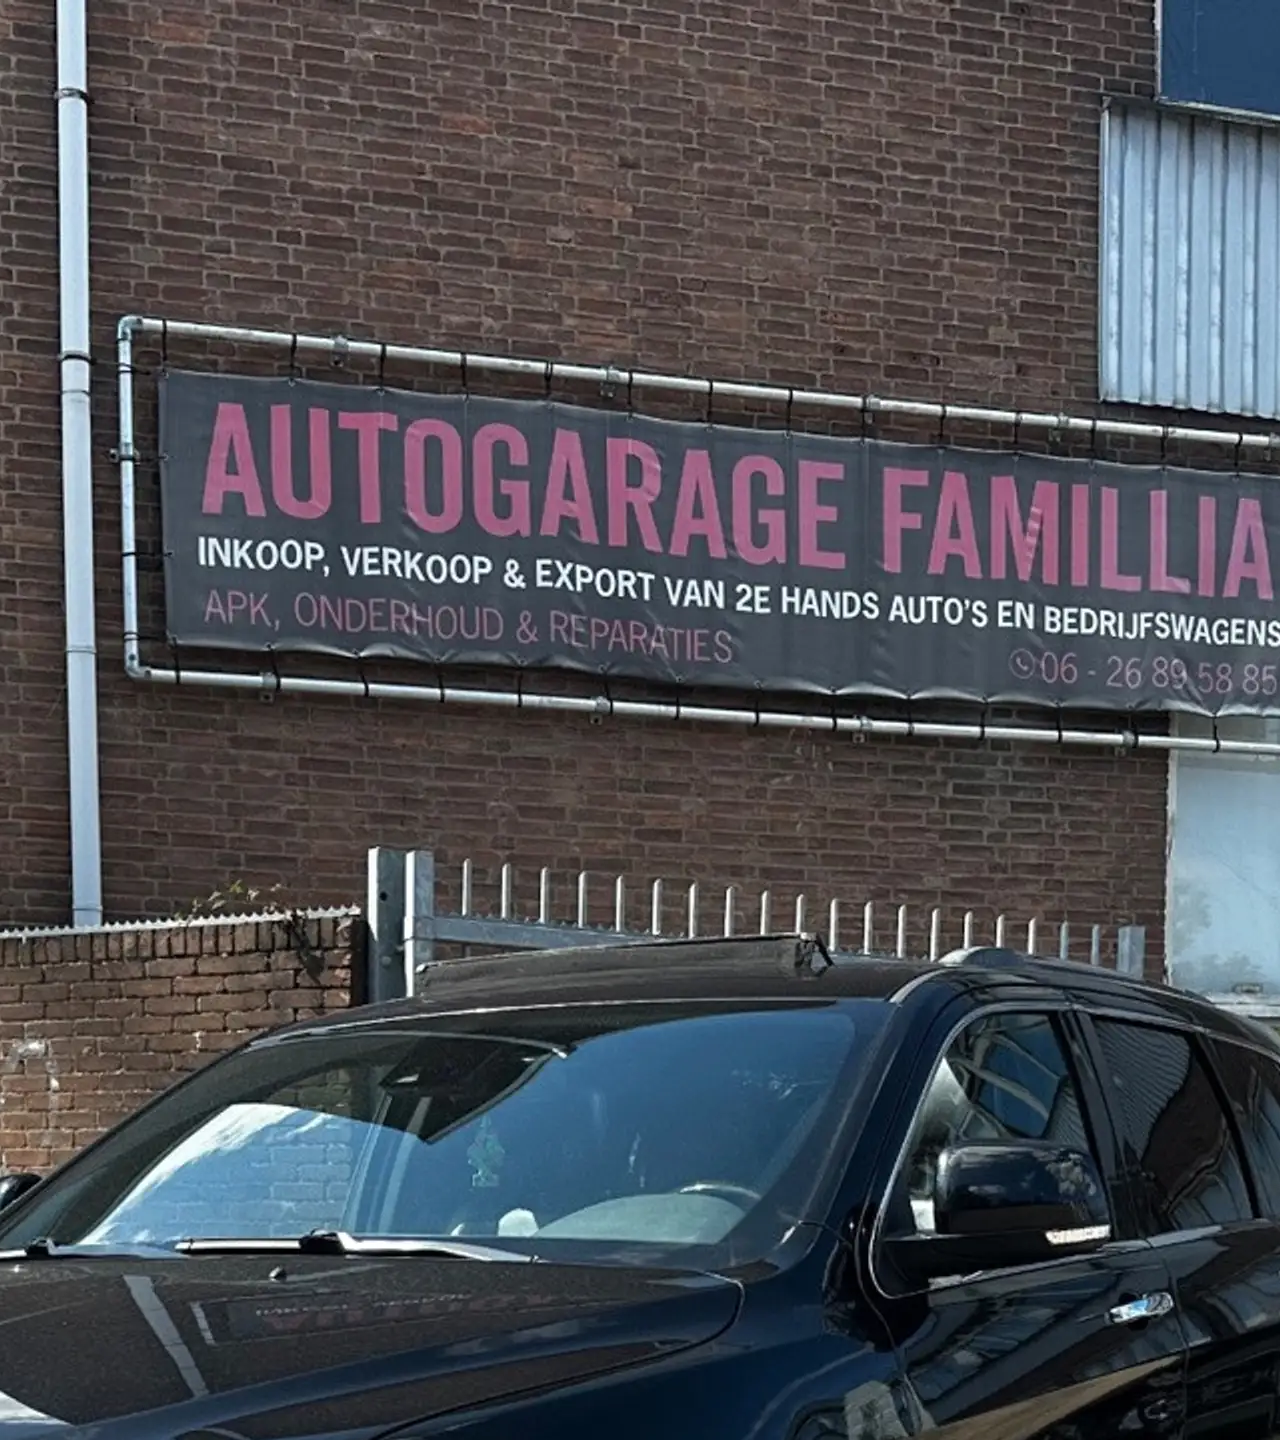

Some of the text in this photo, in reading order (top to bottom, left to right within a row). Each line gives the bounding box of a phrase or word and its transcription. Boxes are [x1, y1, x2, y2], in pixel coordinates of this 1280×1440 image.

[202, 402, 1274, 600] AUTOGARAGE FAMILLIA
[197, 536, 330, 578] INKOOP,
[341, 546, 493, 588] VERKOOP
[504, 558, 527, 588] &
[536, 559, 655, 602] EXPORT
[664, 575, 725, 609] VAN
[735, 584, 771, 615] 2E
[781, 585, 880, 620] HANDS
[888, 595, 988, 629] AUTO'S
[998, 600, 1035, 632] EN
[204, 589, 733, 664] APK, ONDERHOUD & REPARATIES
[1040, 651, 1078, 685] 06
[1106, 655, 1143, 688] 26
[1151, 656, 1187, 691] 89
[1197, 662, 1233, 695] 58
[1241, 663, 1278, 696] 85
